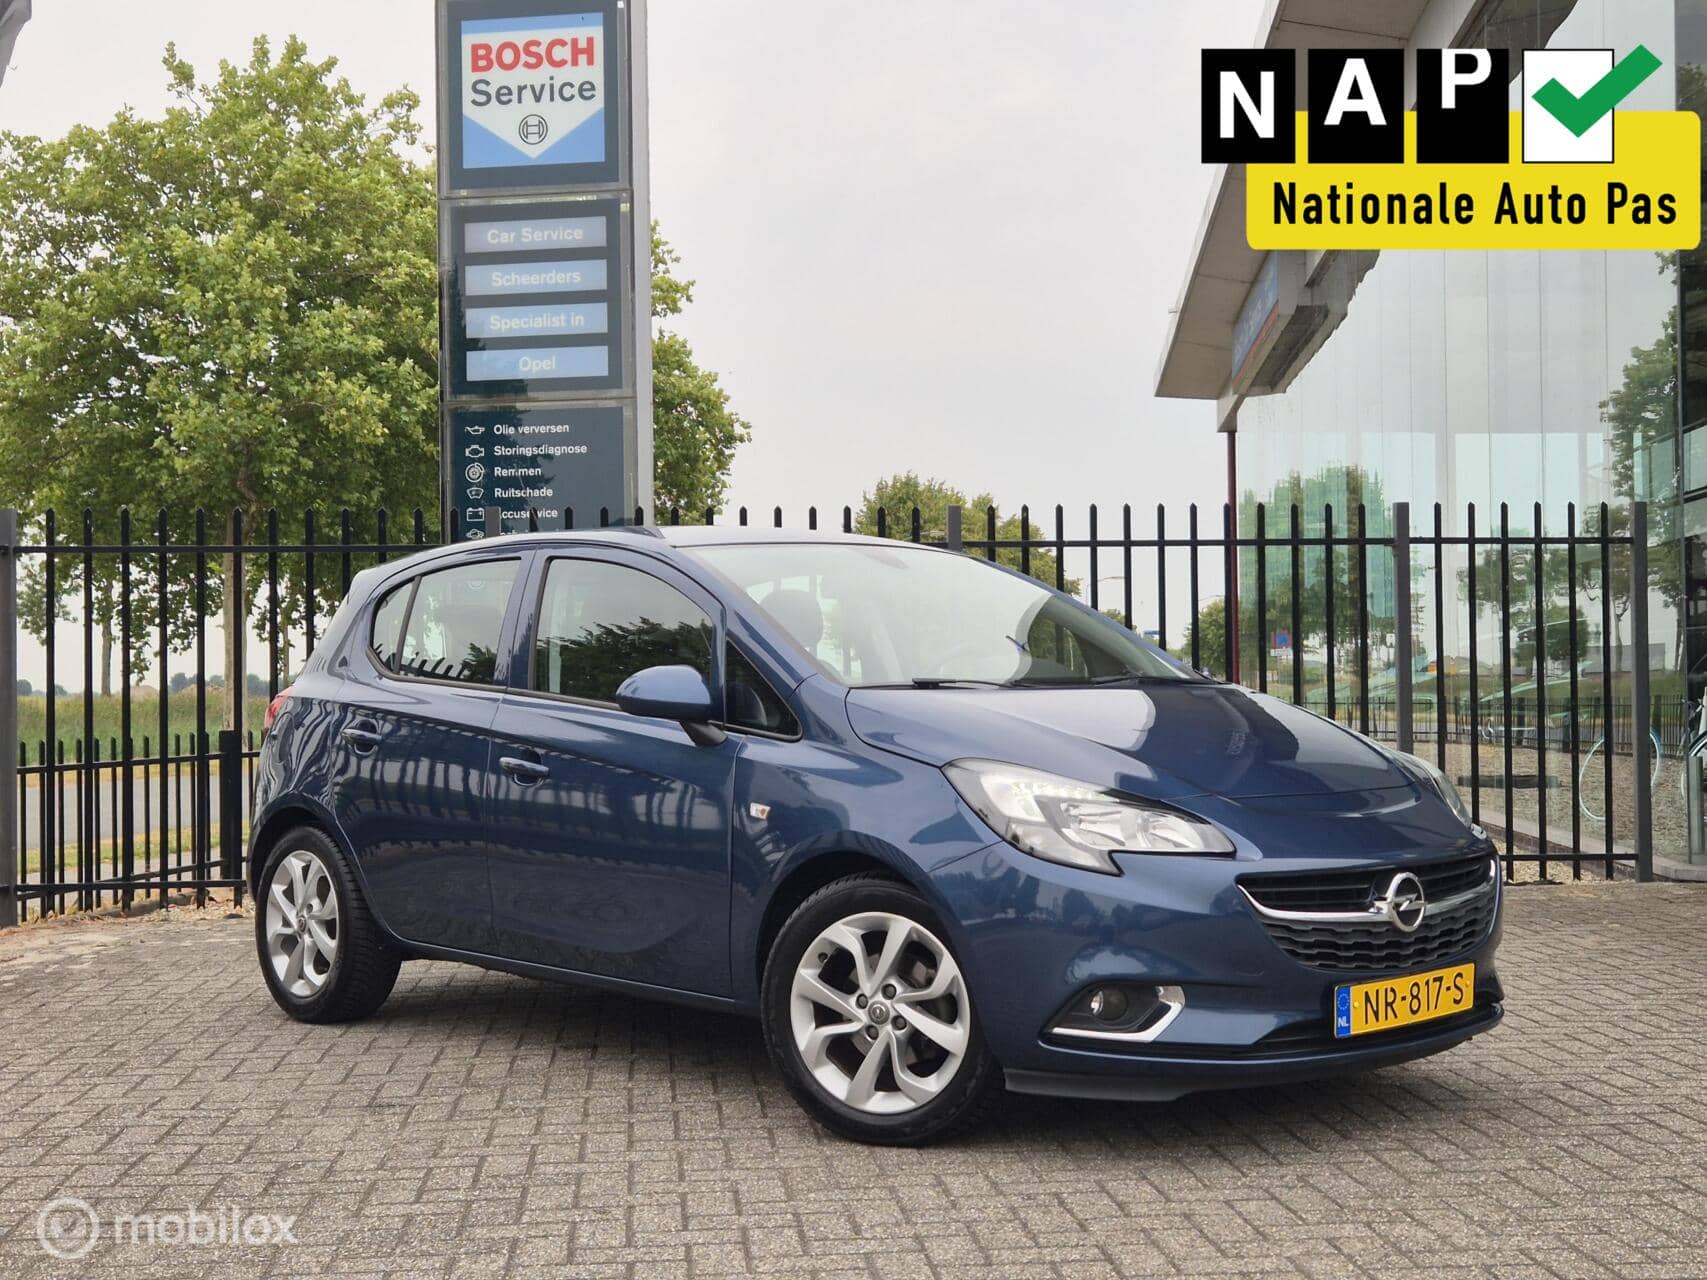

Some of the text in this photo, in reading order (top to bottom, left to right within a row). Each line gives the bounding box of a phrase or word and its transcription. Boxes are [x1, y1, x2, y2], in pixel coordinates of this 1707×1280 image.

[470, 36, 595, 73] BOSCH
[470, 76, 596, 107] Service
[487, 226, 584, 244] Car Service
[491, 270, 582, 287] Scheerders
[489, 313, 585, 331] Specialist in
[518, 356, 556, 373] Opel
[493, 424, 570, 435] Olie verversen
[493, 444, 588, 457] Storingsdiagnose
[494, 466, 542, 477] Remmen
[494, 487, 554, 499] Ruitschade
[500, 508, 559, 519] ccusvice
[1364, 972, 1464, 1025] NR-817-S
[1337, 1016, 1350, 1028] NL
